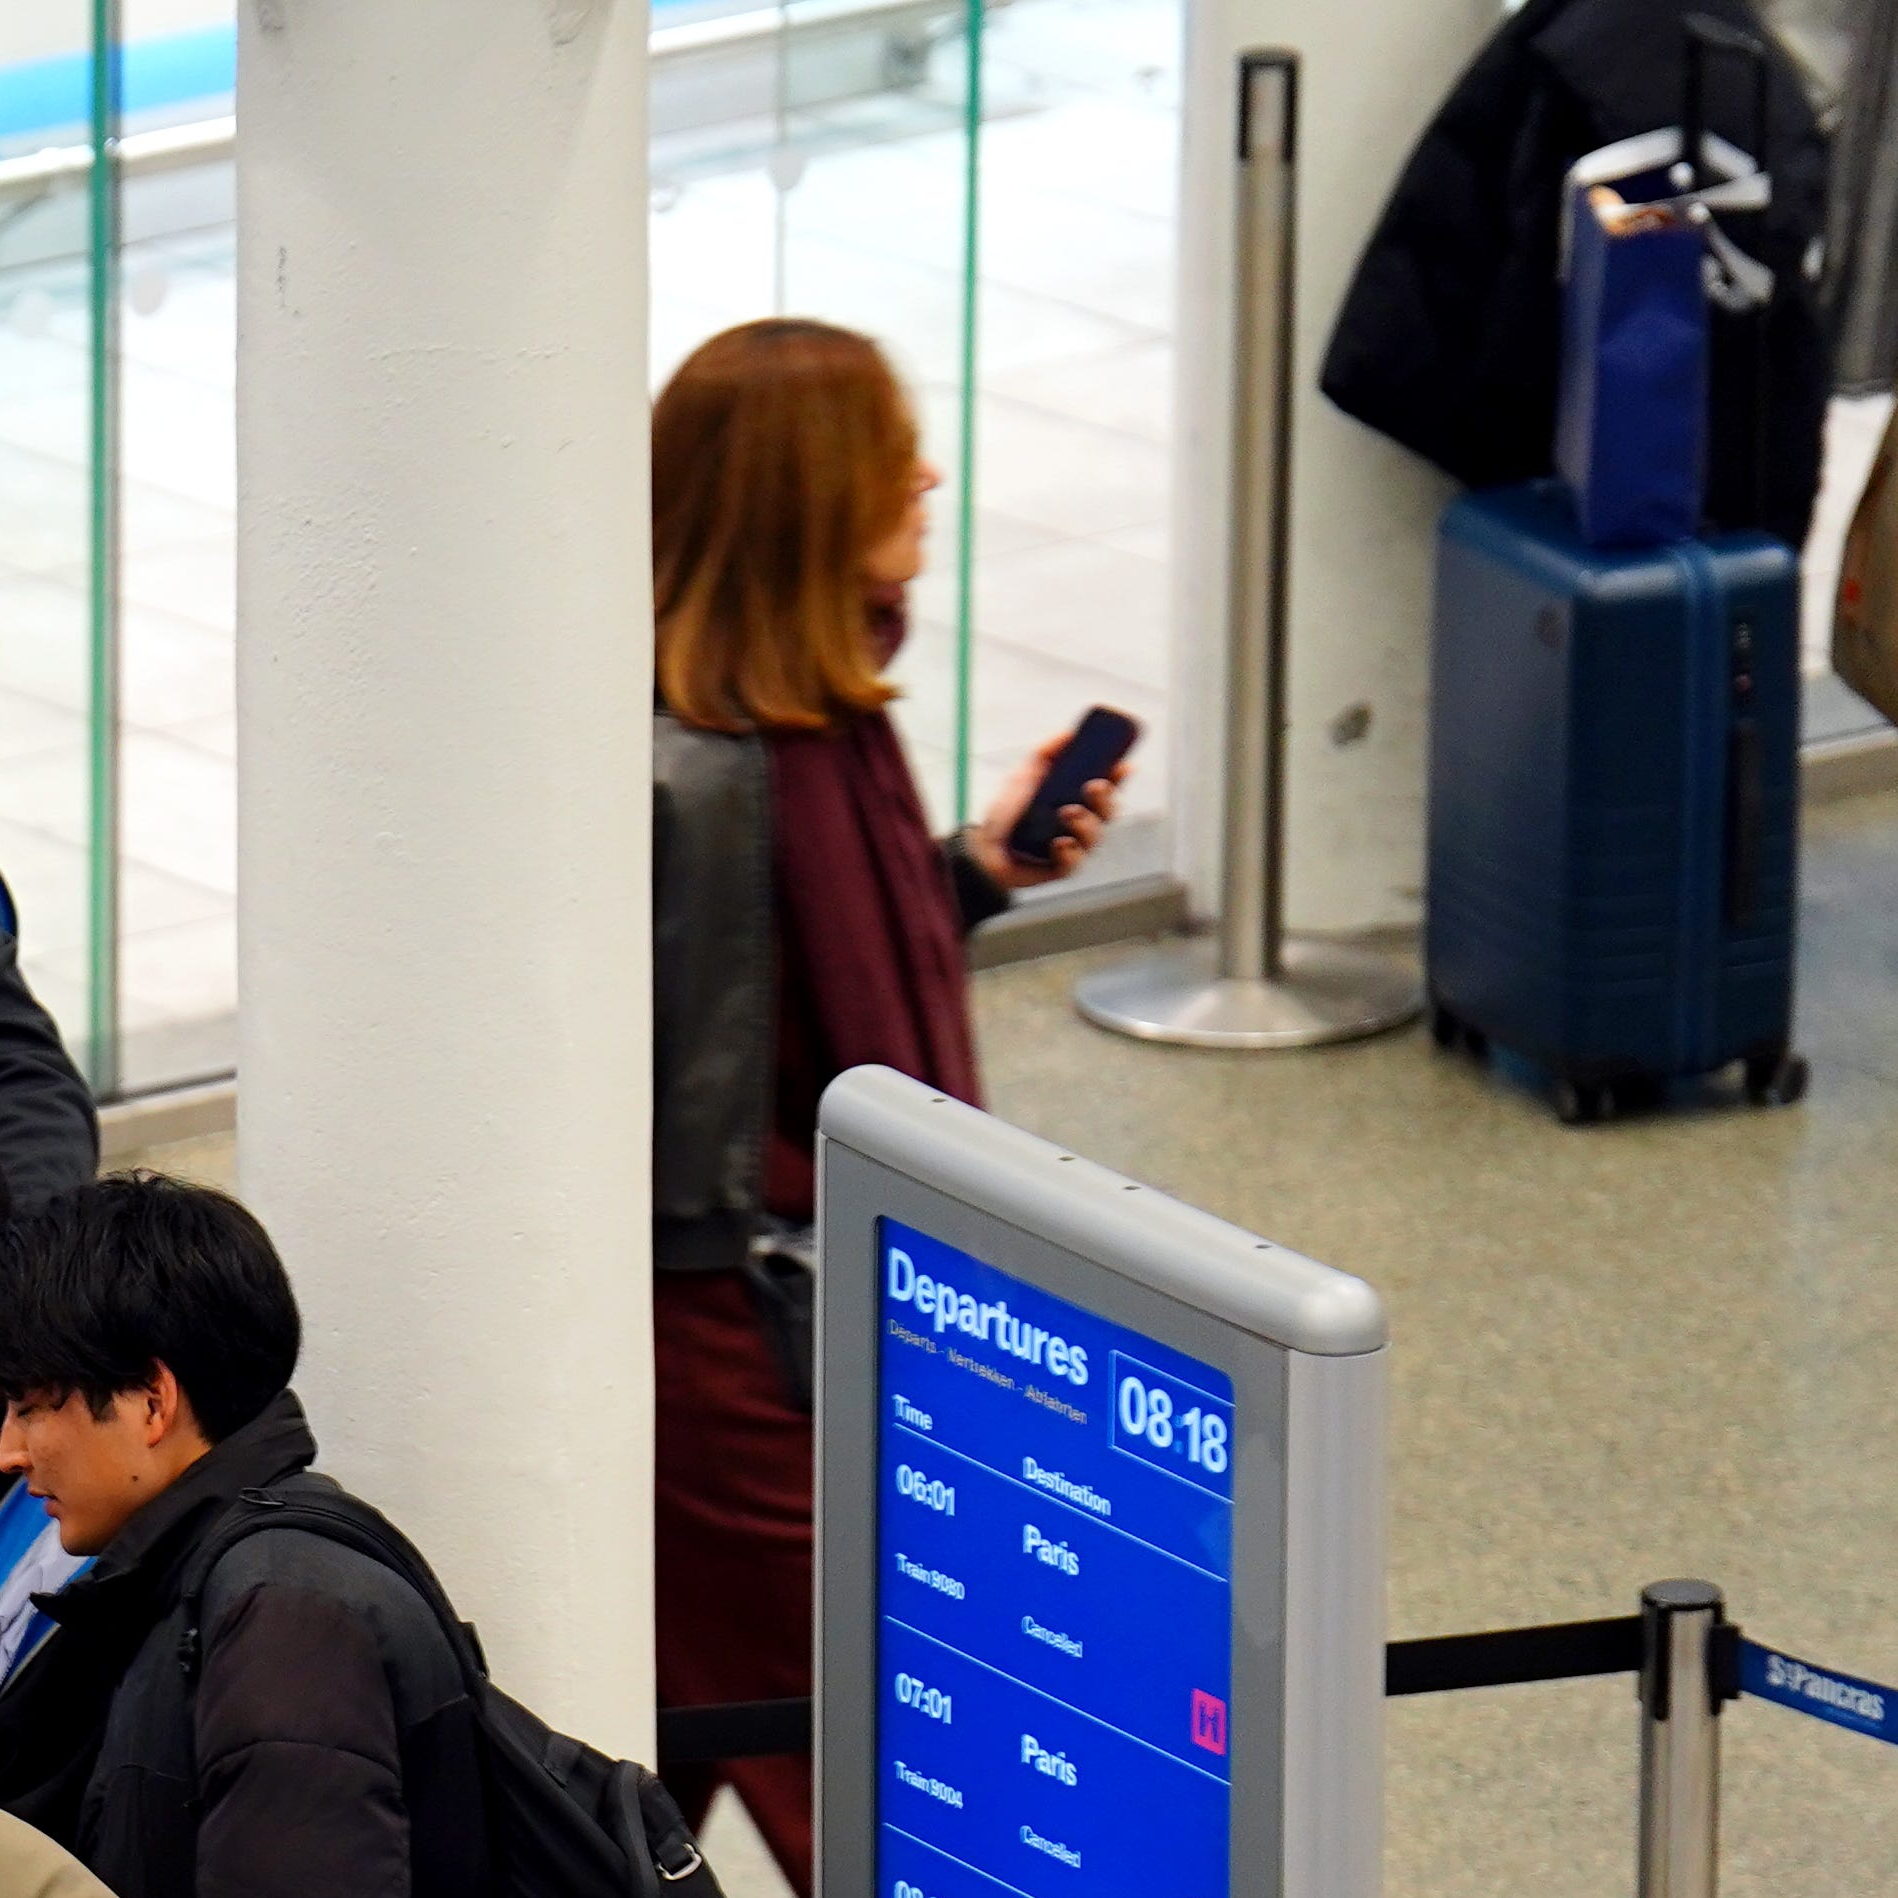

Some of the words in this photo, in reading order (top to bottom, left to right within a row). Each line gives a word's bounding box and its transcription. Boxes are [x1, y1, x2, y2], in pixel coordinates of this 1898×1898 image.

[887, 1247, 1089, 1385] Departures
[892, 1394, 933, 1431] Time
[1022, 1456, 1111, 1516] Destination
[1118, 1376, 1228, 1473] 08:18
[896, 1464, 955, 1516] 06:01
[1022, 1524, 1079, 1576] Paris
[895, 1553, 931, 1585] Train
[1021, 1615, 1083, 1658] Cancelled
[895, 1672, 952, 1724] 07:01
[1020, 1733, 1077, 1786] Paris
[1790, 1661, 1885, 1722] Pancras
[893, 1760, 929, 1793] Train
[1019, 1825, 1081, 1869] Cancelled
